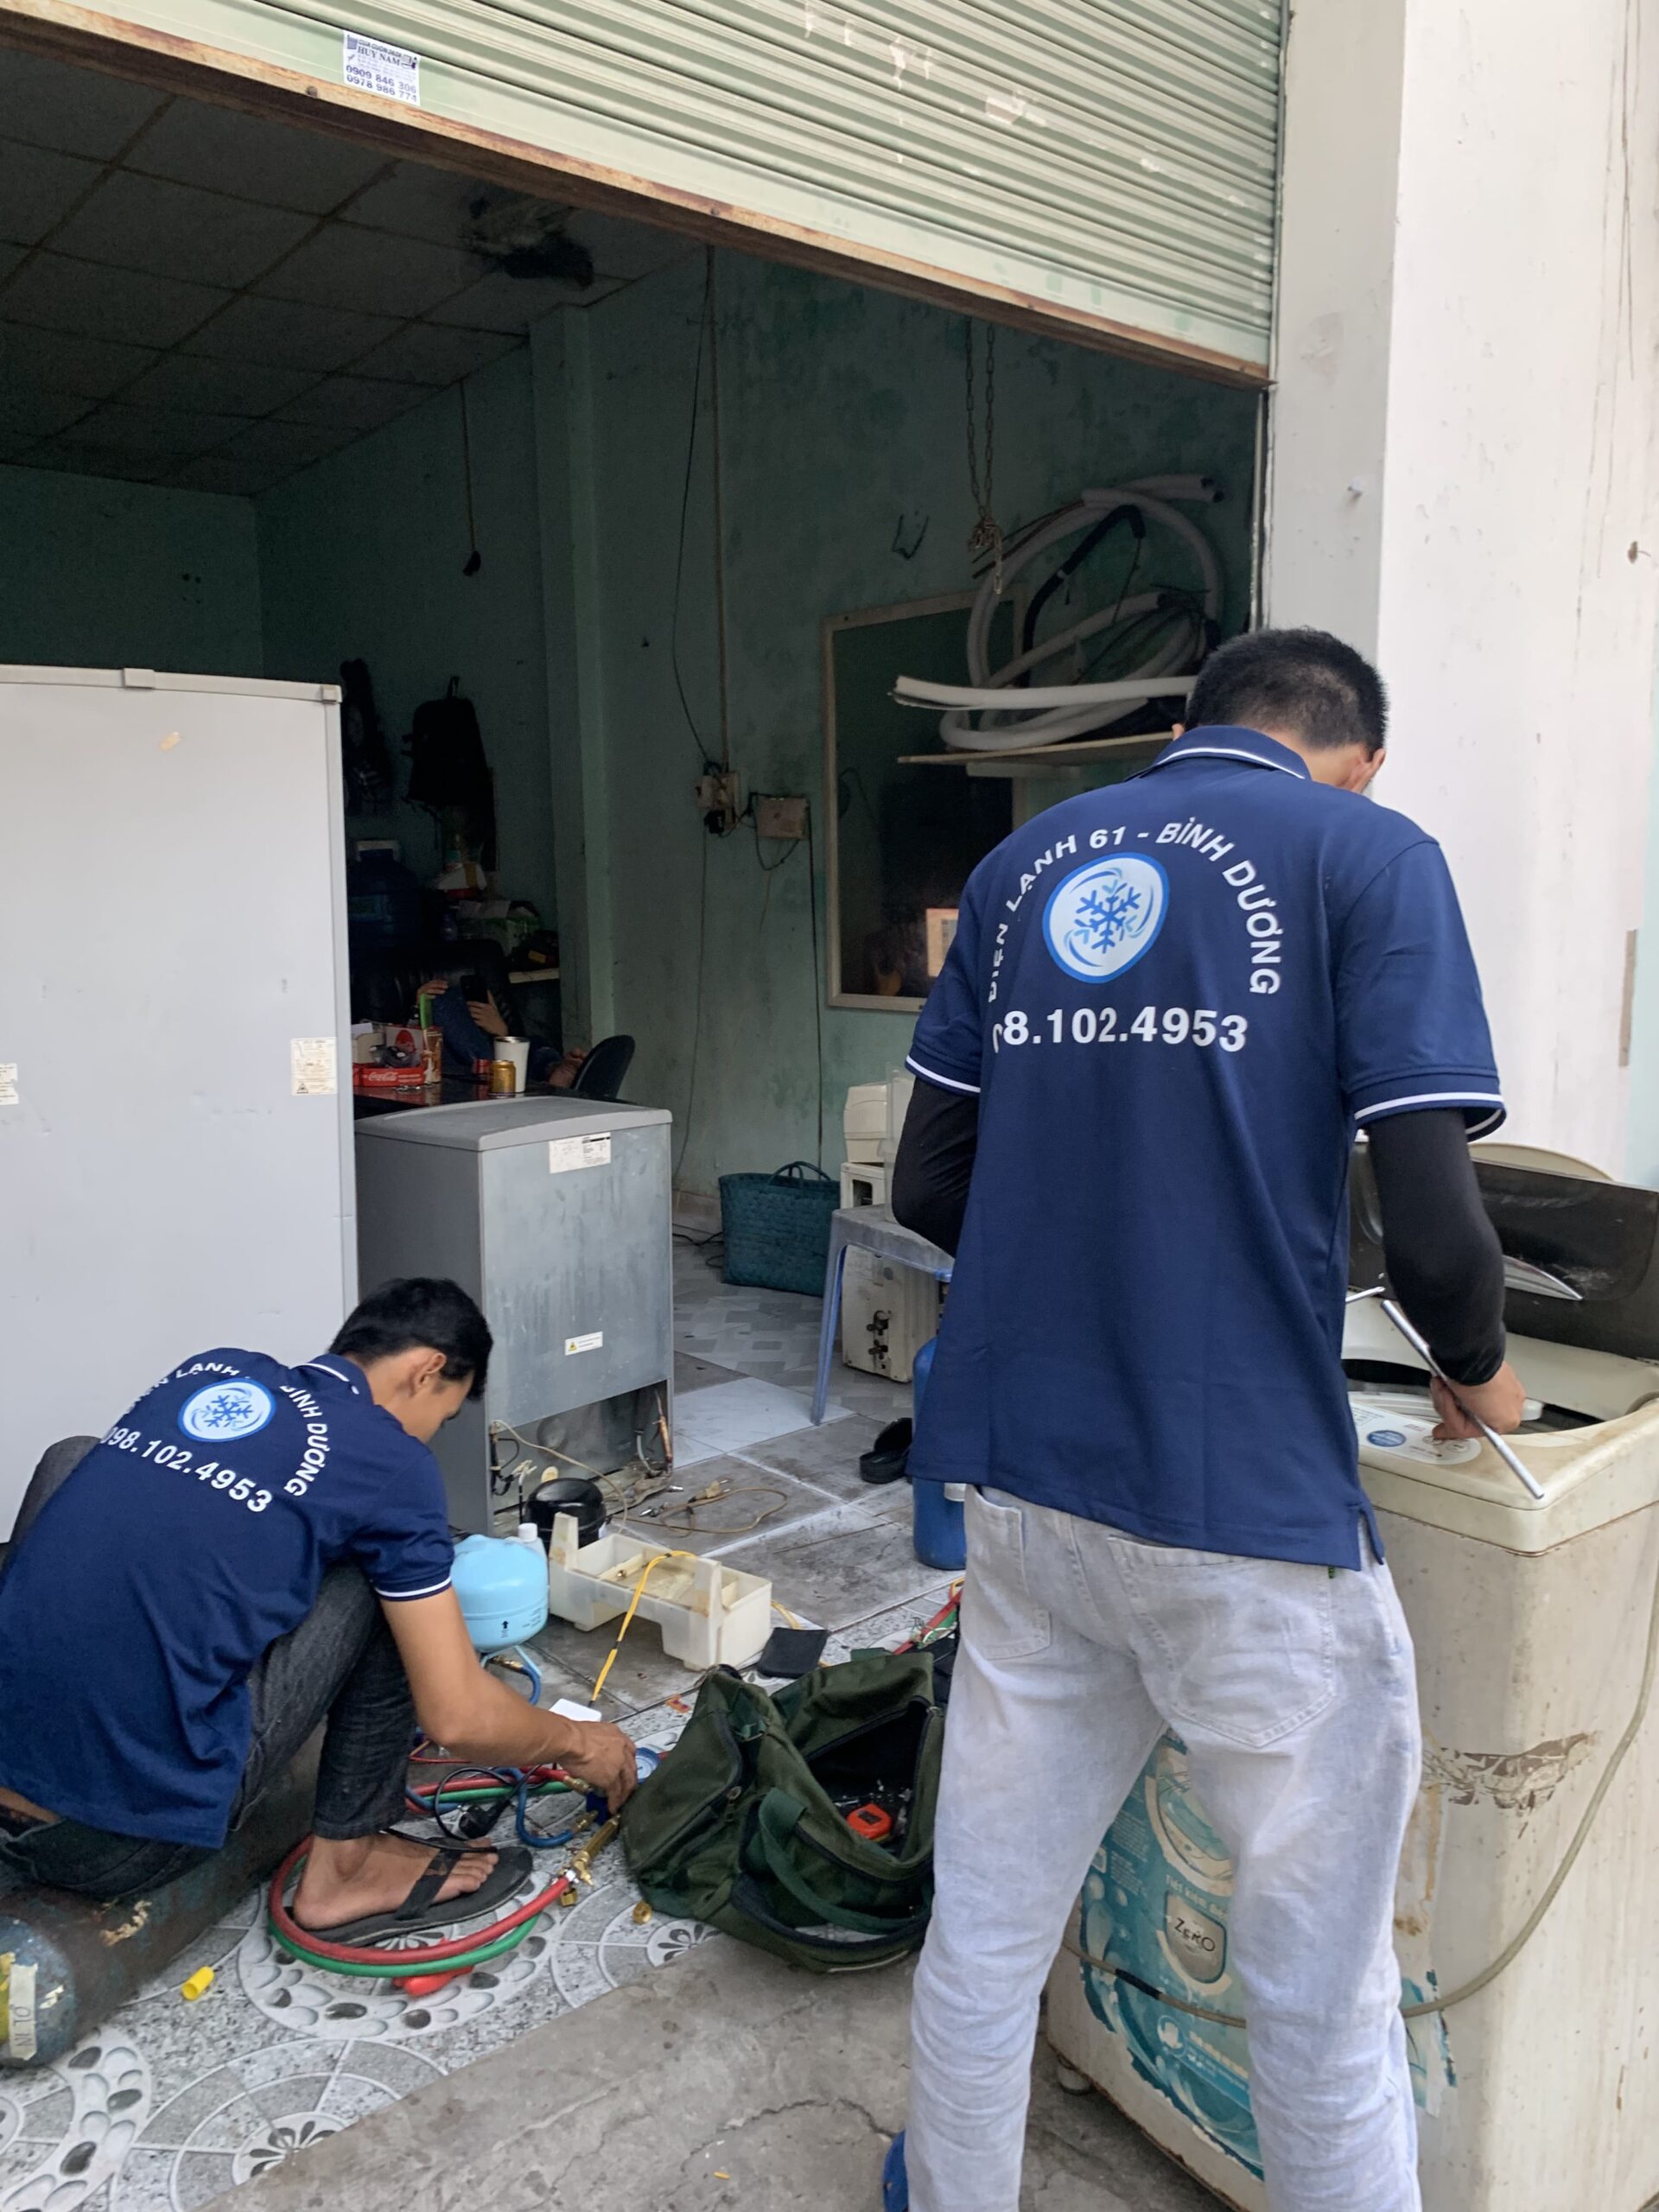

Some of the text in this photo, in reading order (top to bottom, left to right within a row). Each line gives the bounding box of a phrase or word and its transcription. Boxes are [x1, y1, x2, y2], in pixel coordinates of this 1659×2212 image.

[358, 46, 378, 58] HUY
[380, 53, 400, 66] NAM
[346, 65, 372, 79] 0909
[375, 74, 395, 86] 846
[398, 81, 416, 93] 306
[346, 74, 372, 89] 0978
[376, 84, 396, 96] 986
[1006, 835, 1077, 912] LẠNH
[1089, 825, 1127, 849] 61
[1222, 860, 1283, 995] DƯƠNG
[992, 1006, 1248, 1053] 8.102.4953
[175, 1362, 240, 1378] LẠNH
[283, 1423, 330, 1496] DƯƠNG
